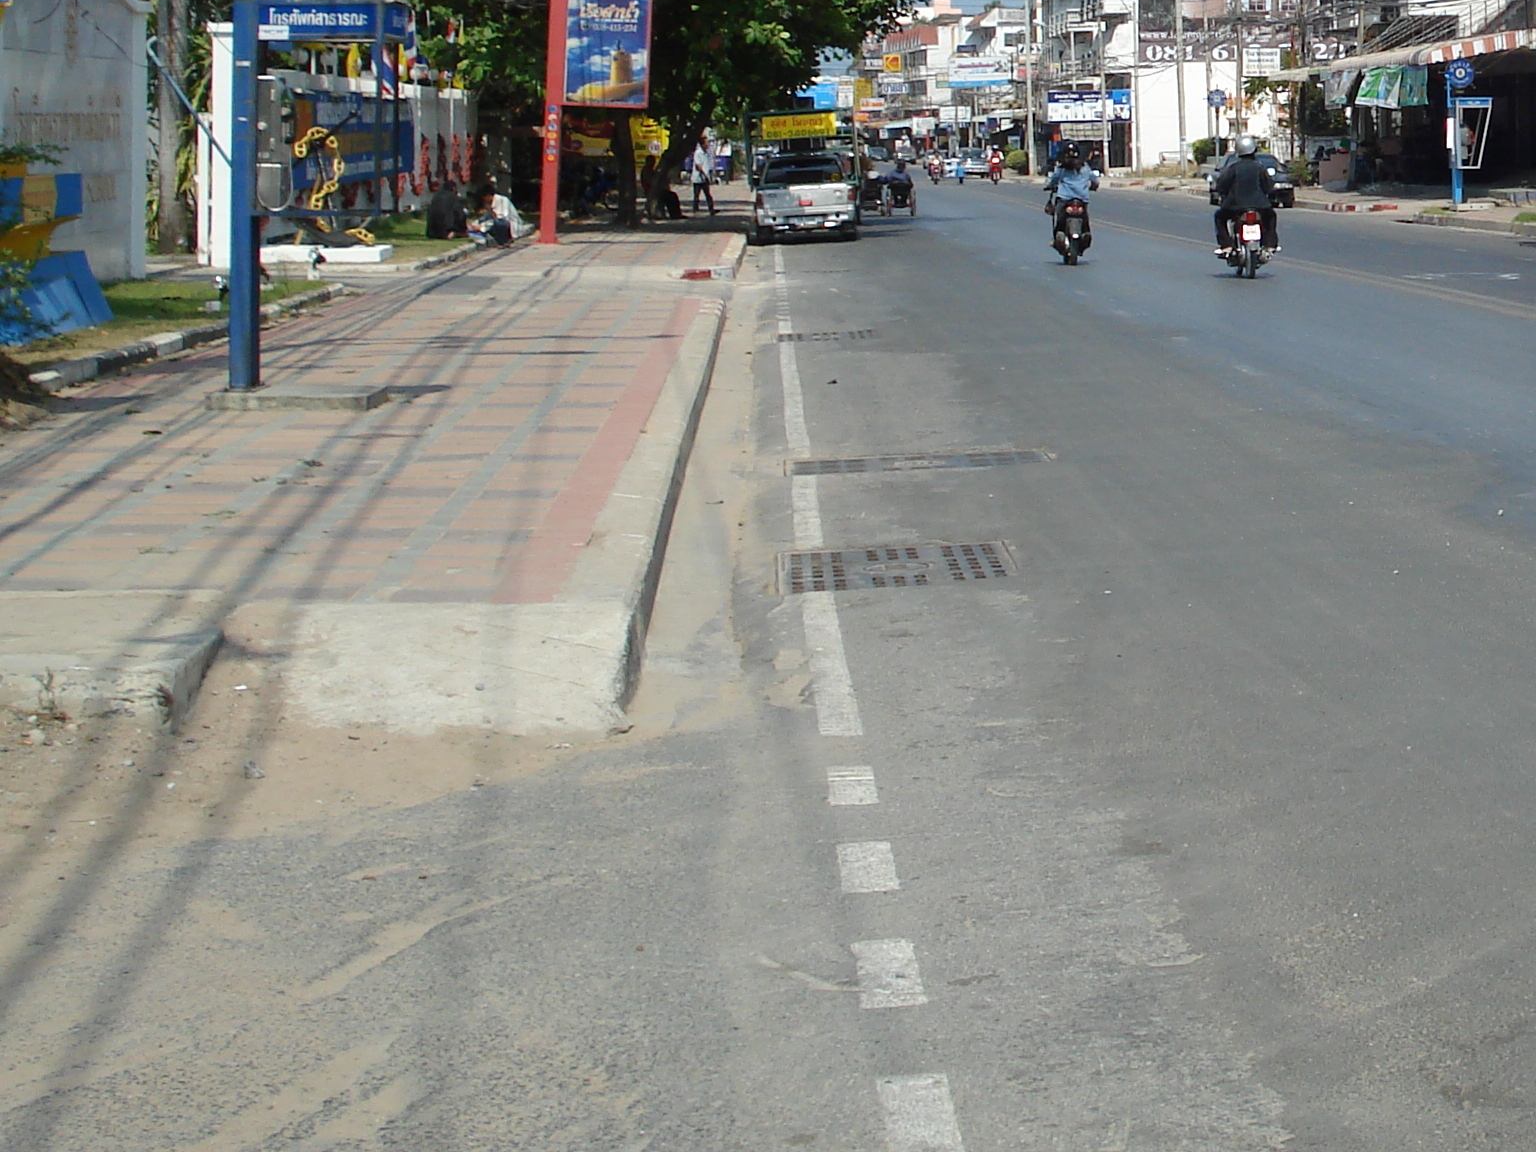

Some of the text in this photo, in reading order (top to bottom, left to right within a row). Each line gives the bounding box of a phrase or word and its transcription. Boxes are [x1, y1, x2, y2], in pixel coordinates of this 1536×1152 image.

[269, 8, 368, 26] โทรศัพท์สาธารณะ
